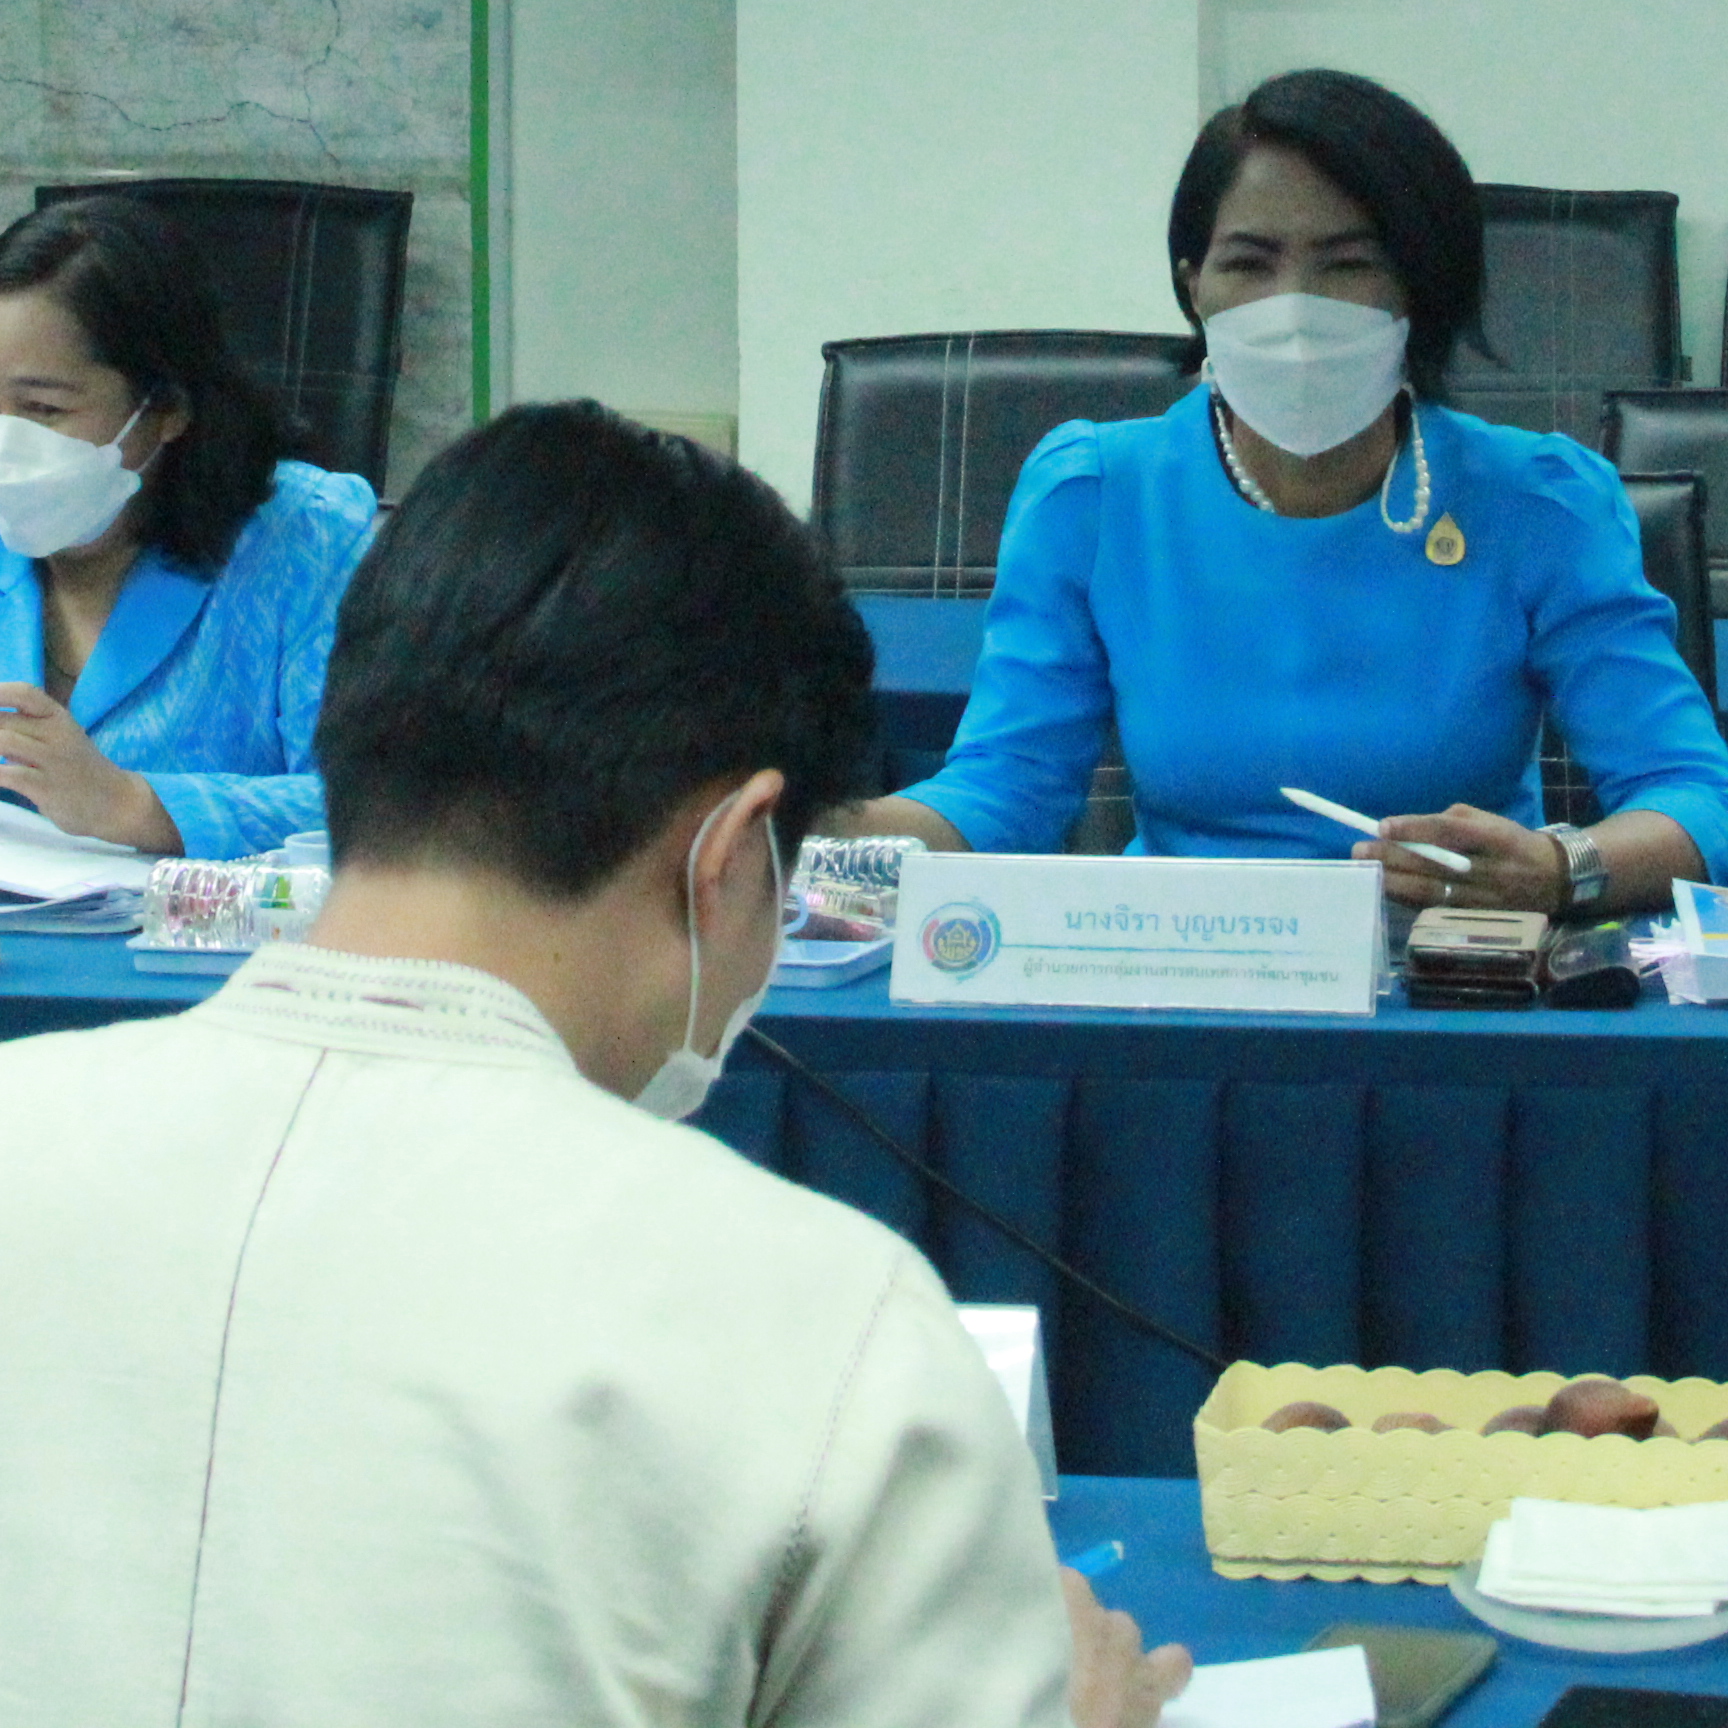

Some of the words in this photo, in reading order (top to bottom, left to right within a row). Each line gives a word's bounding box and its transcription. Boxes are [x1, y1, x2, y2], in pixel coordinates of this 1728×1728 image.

[1064, 902, 1160, 932] นางจิรา
[1171, 913, 1300, 943] บุญบรรจง
